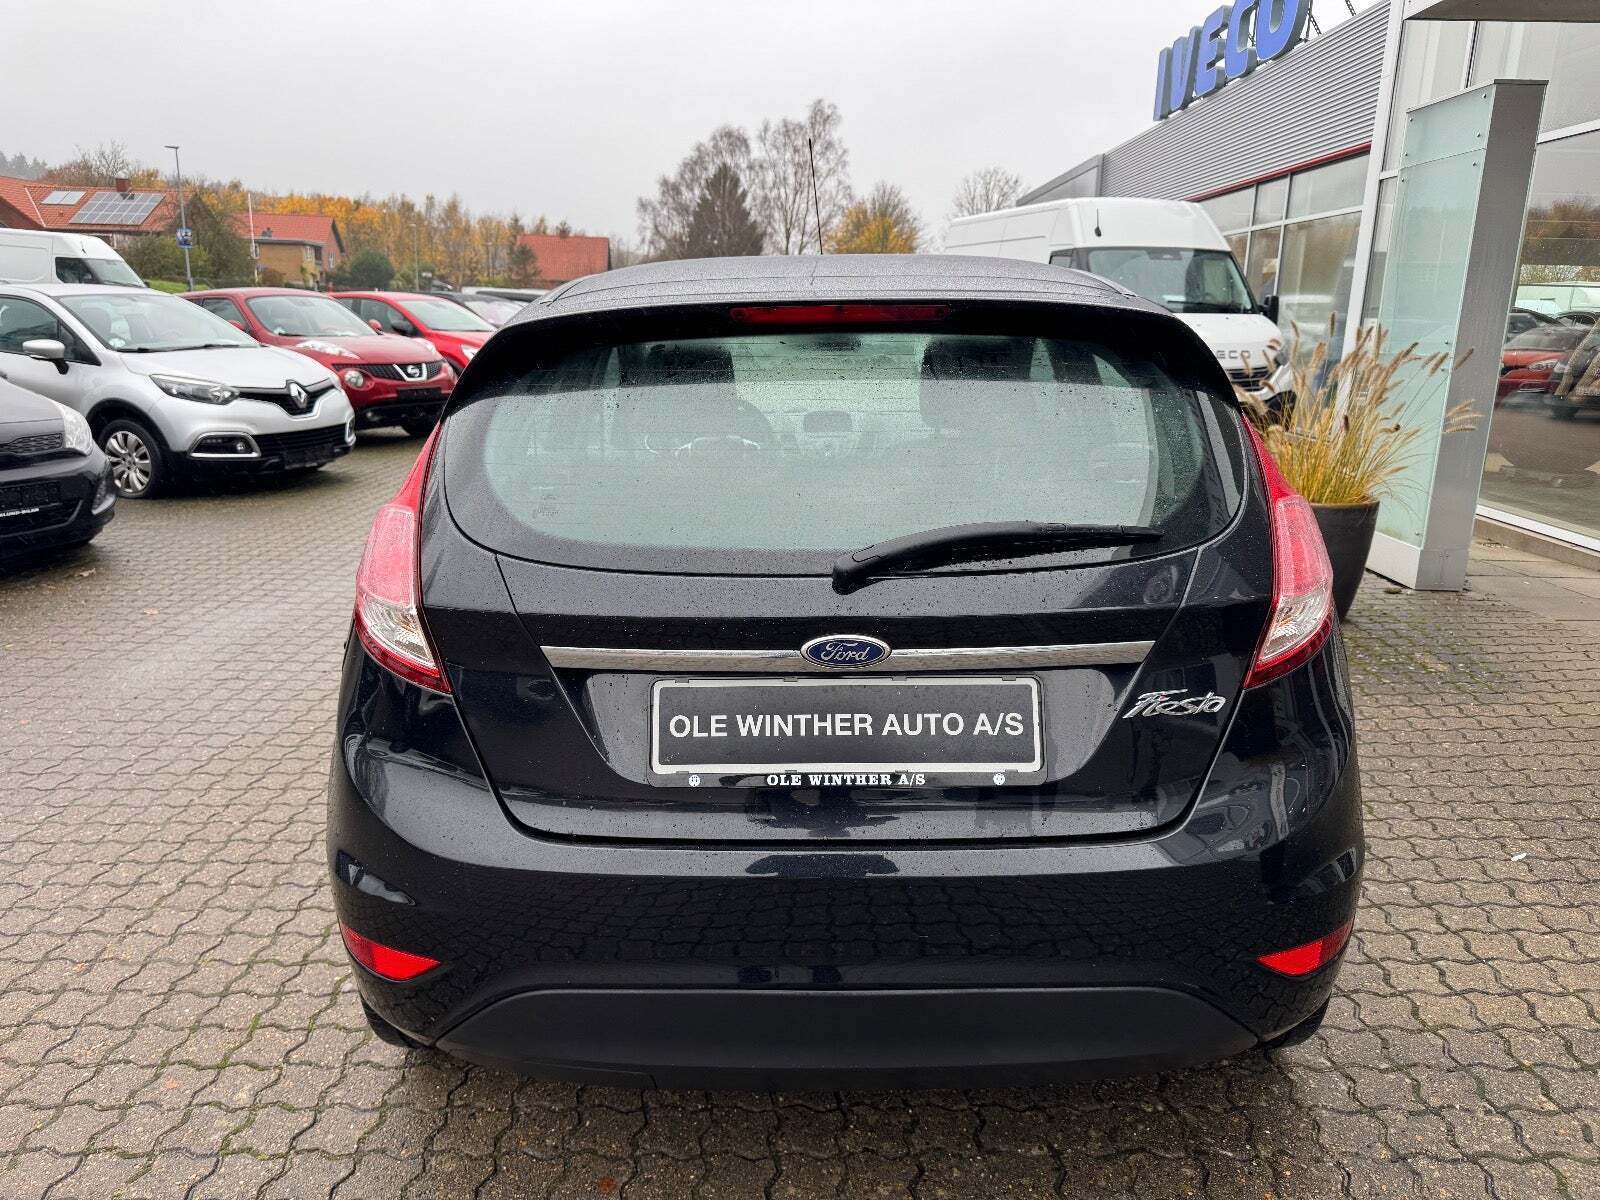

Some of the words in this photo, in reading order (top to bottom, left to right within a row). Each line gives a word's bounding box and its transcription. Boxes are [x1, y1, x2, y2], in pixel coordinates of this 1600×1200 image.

[1153, 0, 1312, 121] IVECO
[1216, 350, 1250, 359] ECO
[820, 642, 871, 661] Ford
[1122, 688, 1226, 719] Fiesta
[669, 714, 728, 738] OLE
[735, 713, 873, 737] WINTHER
[881, 712, 965, 736] AUTO
[972, 712, 1024, 736] A/S
[766, 774, 802, 786] OLE
[809, 773, 892, 786] WINTHER
[898, 773, 926, 787] A/S
